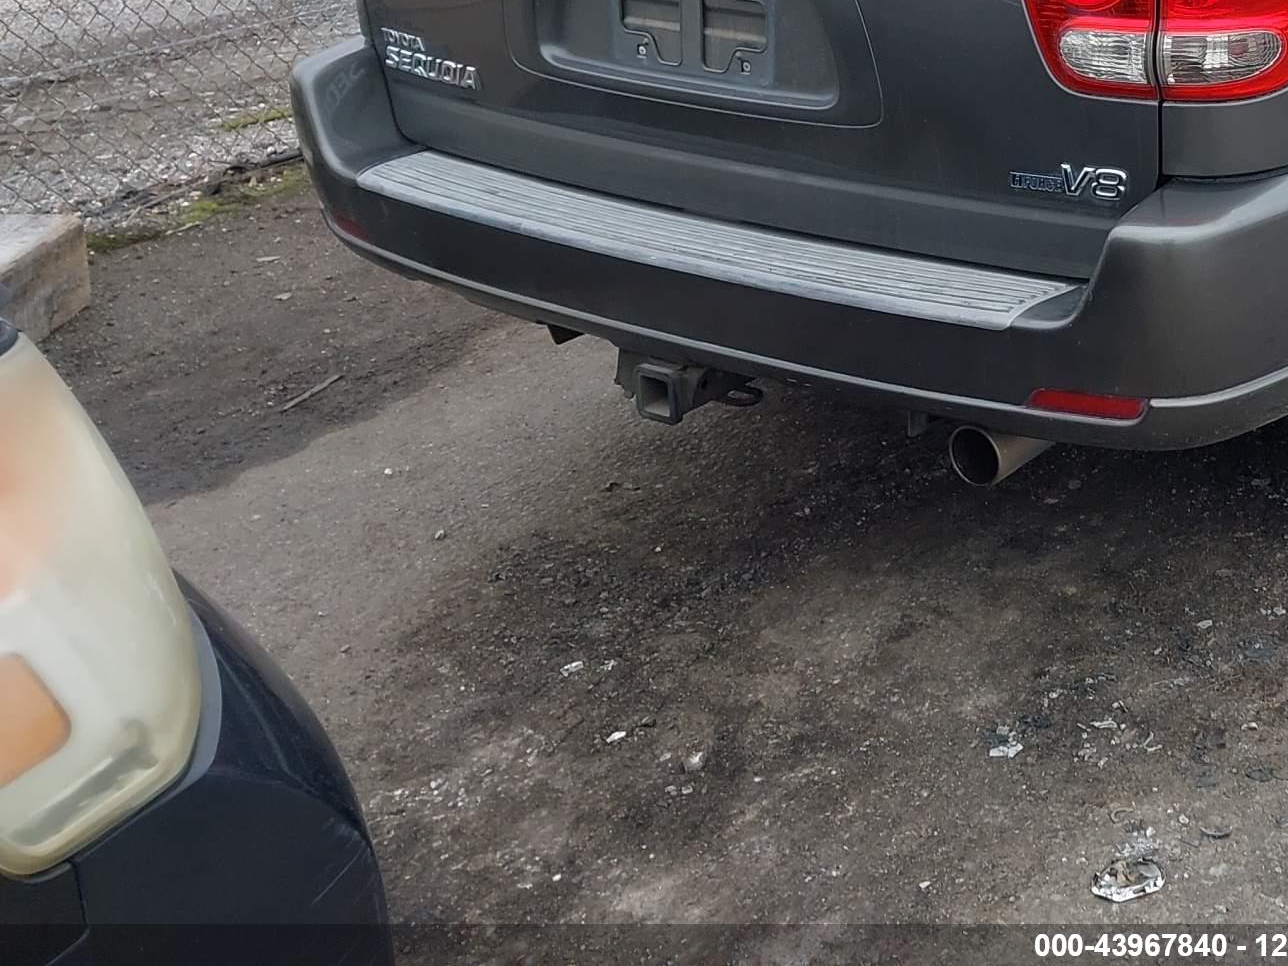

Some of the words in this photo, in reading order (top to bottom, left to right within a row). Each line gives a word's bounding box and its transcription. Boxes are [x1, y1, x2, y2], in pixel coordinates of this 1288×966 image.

[381, 27, 426, 52] TOYOTA
[385, 45, 480, 90] SEQUOIA
[1060, 163, 1128, 201] V8
